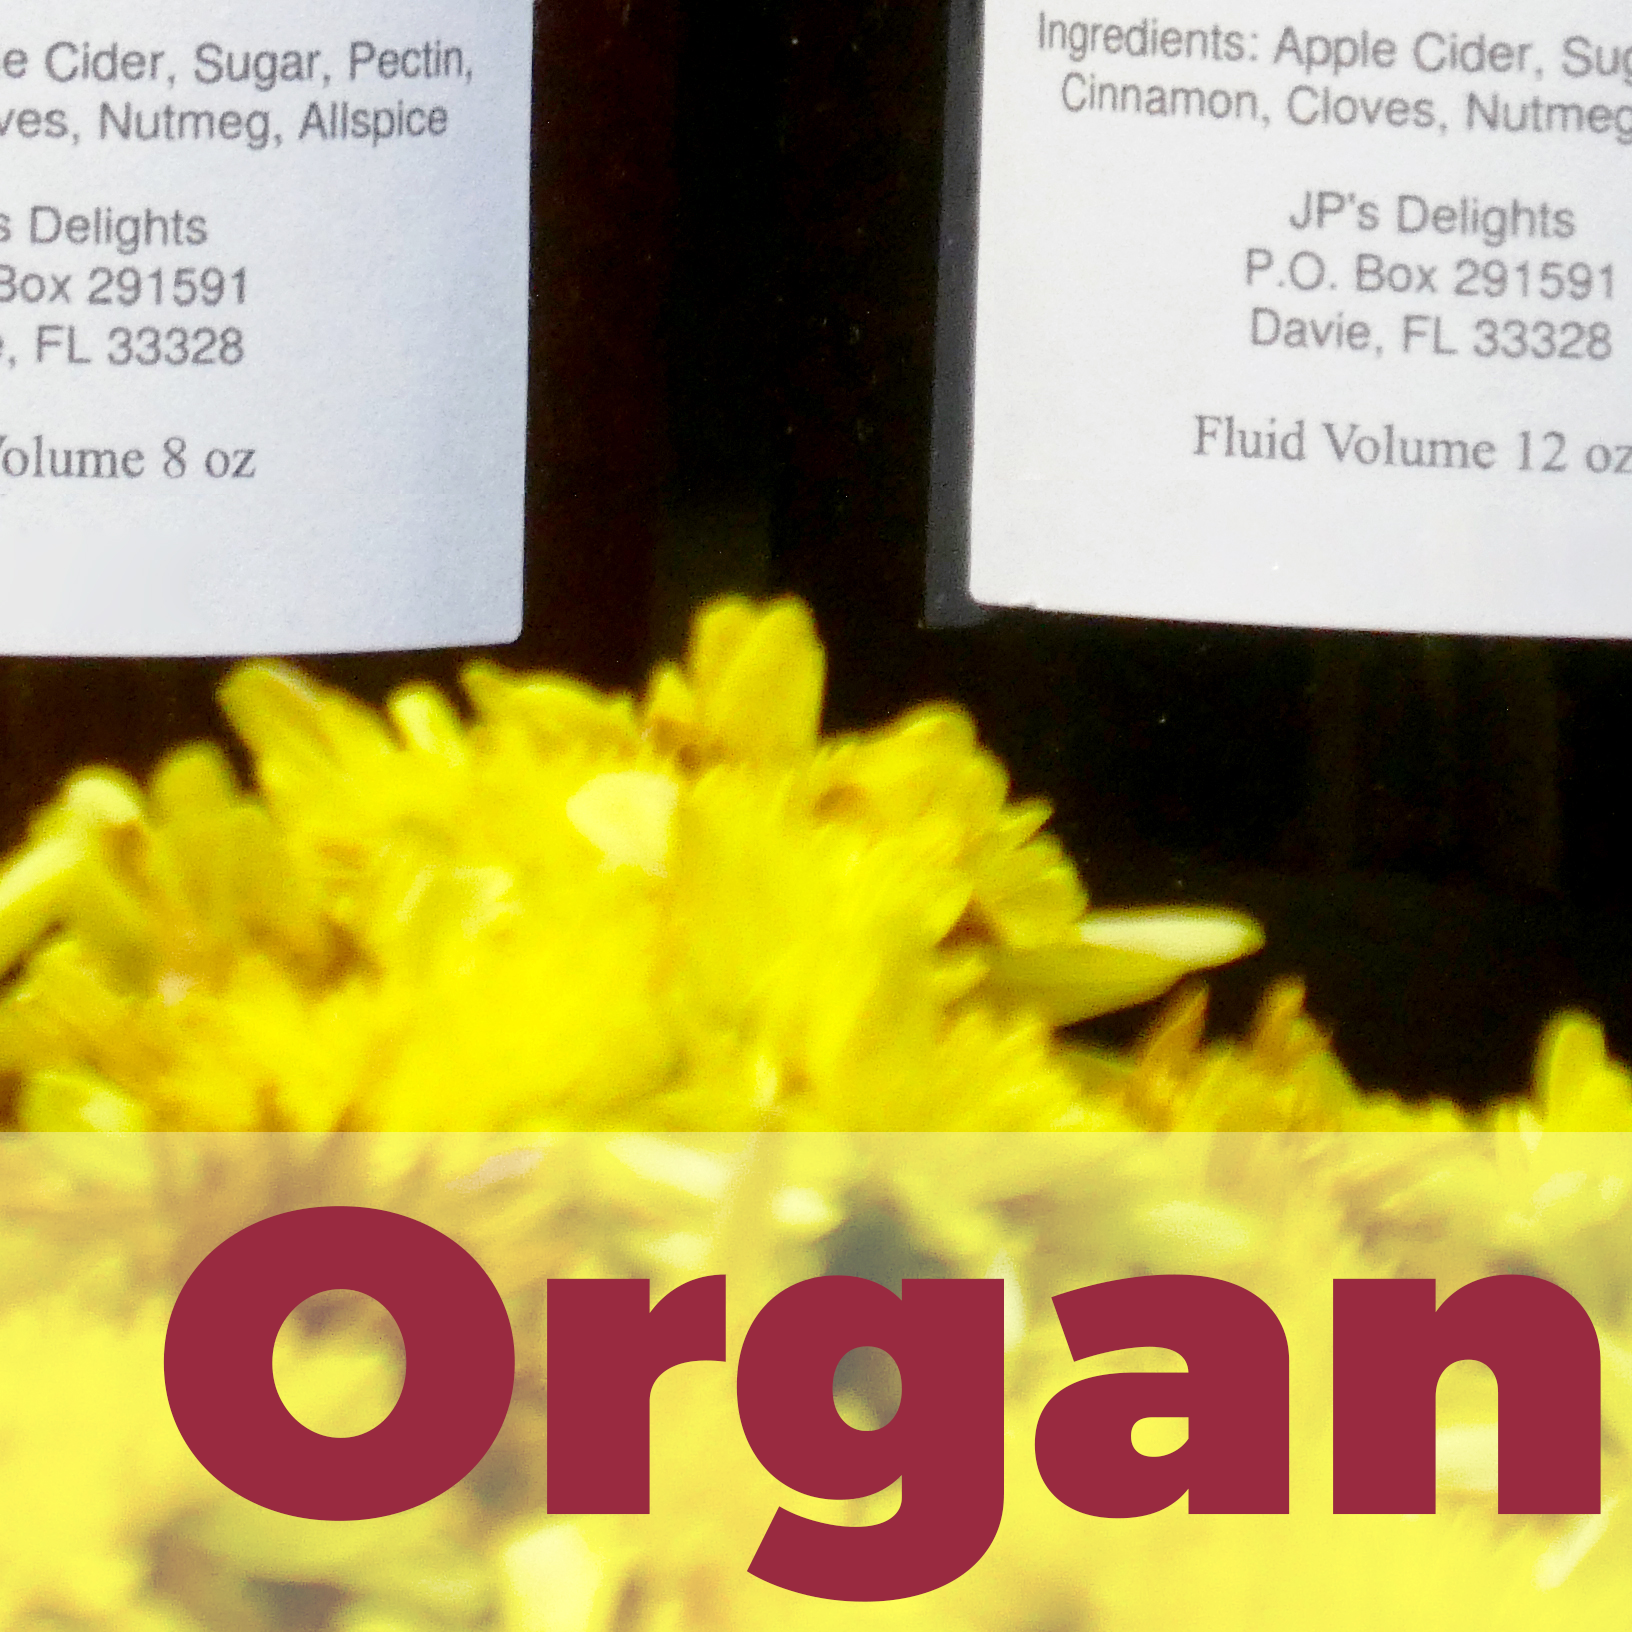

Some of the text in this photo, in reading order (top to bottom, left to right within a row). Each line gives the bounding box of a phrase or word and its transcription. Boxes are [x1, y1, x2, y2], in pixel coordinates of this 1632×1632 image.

[45, 41, 175, 88] Cider,
[195, 42, 330, 92] Sugar,
[350, 40, 472, 84] Pectin,
[1039, 11, 1257, 62] Ingredients:
[1274, 26, 1397, 75] Apple
[1413, 32, 1542, 76] Cider,
[100, 102, 282, 150] Nutmeg,
[298, 100, 449, 147] Allspice
[1062, 72, 1270, 124] Cinnamon,
[1287, 85, 1447, 133] Cloves,
[30, 206, 208, 255] Delights
[1289, 190, 1575, 248] JP's Delights
[87, 267, 245, 307] 291591
[1246, 248, 1612, 301] P.O. Box 291591
[36, 324, 91, 364] FL
[108, 326, 244, 366] 33328
[1251, 307, 1611, 361] Davie, FL 33328
[163, 437, 186, 479] 8
[205, 449, 256, 478] oz
[1194, 415, 1305, 461] Fluid
[1322, 423, 1495, 470] Volume
[1519, 431, 1567, 472] 12
